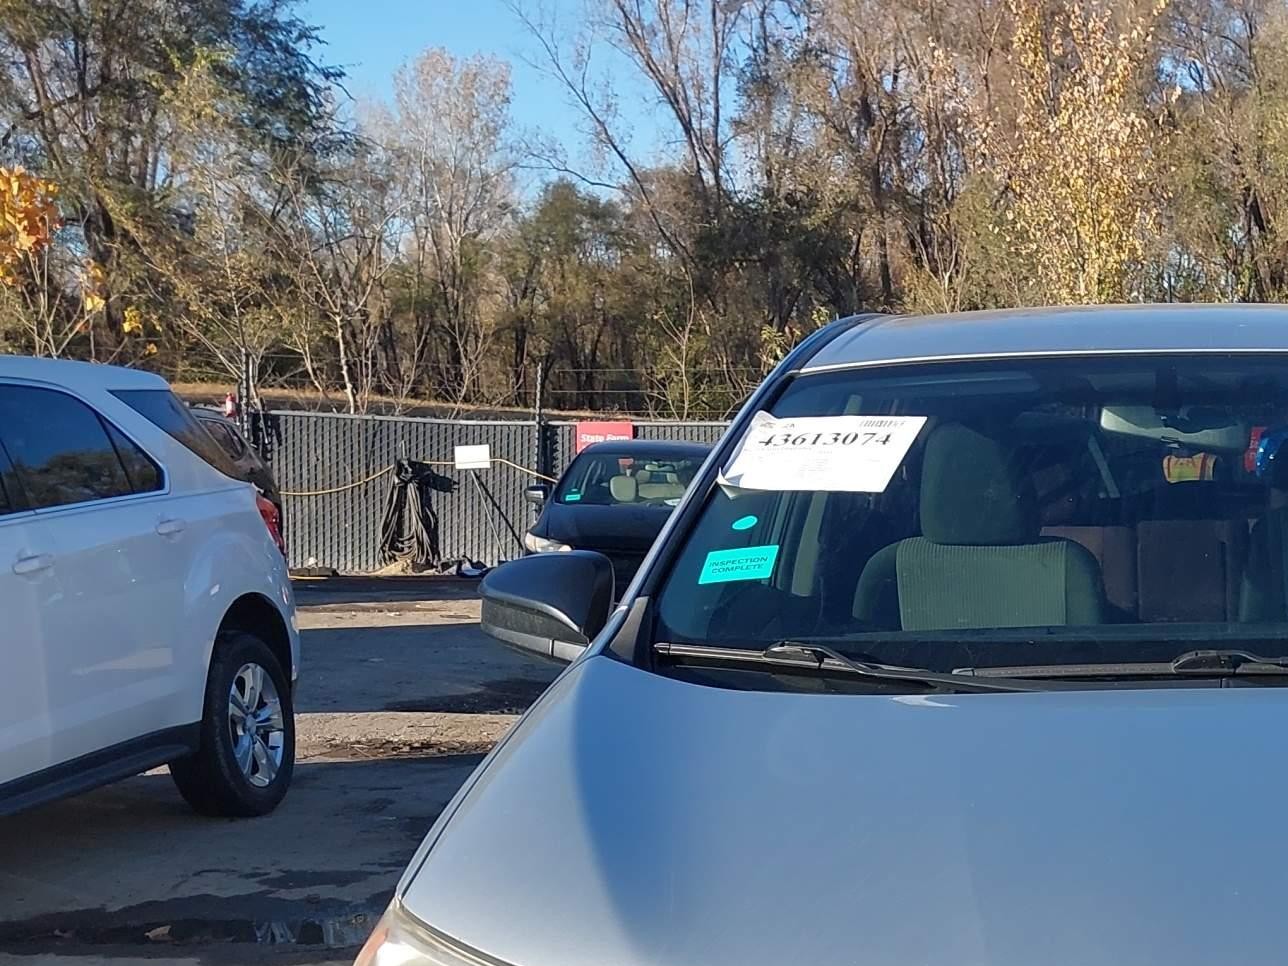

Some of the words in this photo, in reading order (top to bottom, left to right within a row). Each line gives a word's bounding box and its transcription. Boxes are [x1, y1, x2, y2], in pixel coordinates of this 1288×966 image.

[758, 432, 893, 447] 43613074
[708, 556, 769, 568] INSPECTION
[711, 564, 765, 574] COMPLETE
